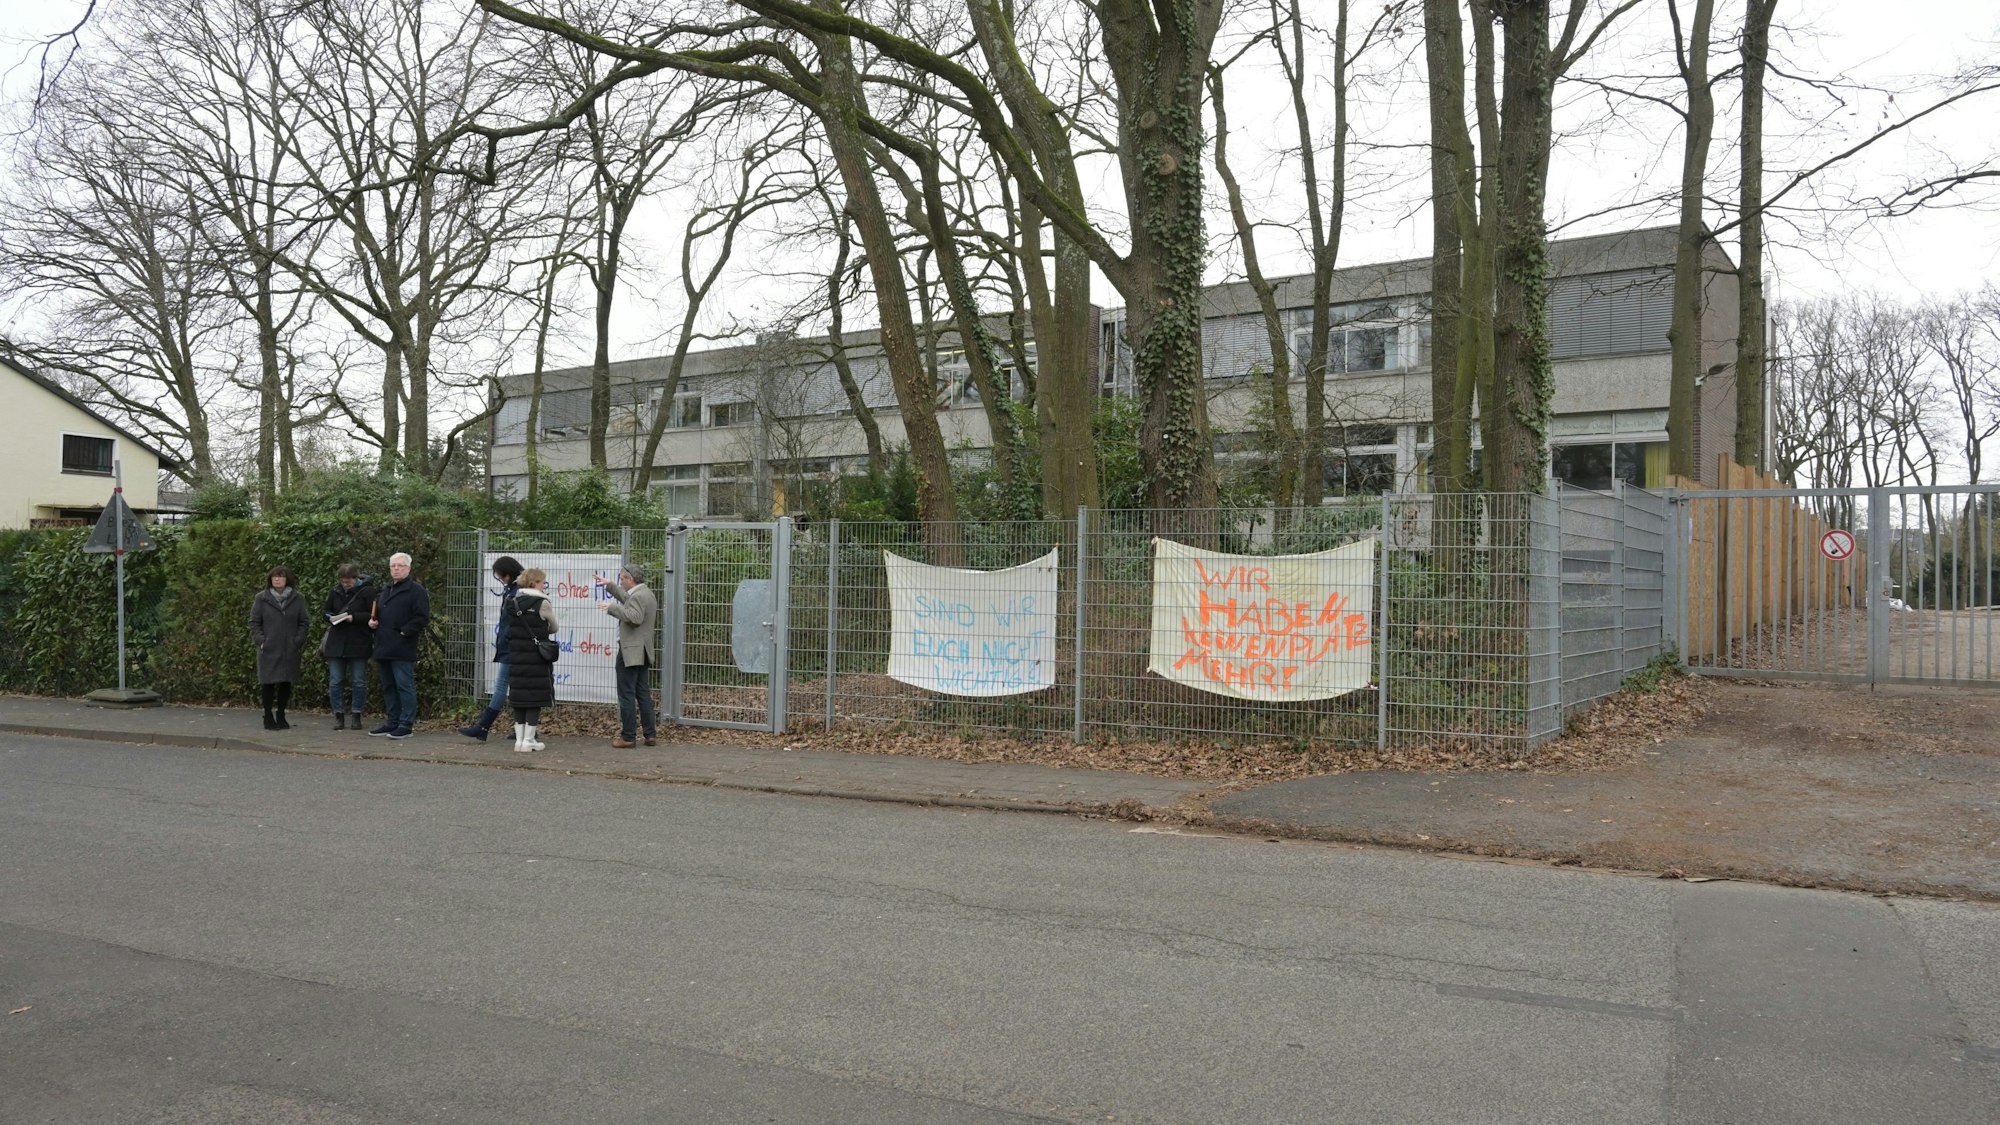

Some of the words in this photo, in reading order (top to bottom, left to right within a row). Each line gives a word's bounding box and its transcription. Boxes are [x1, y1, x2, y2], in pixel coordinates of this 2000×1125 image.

[558, 571, 589, 599] ohne
[1194, 558, 1271, 593] WIR
[914, 595, 976, 628] SIND
[991, 595, 1035, 628] WIR
[1199, 589, 1348, 636] HABEN
[580, 631, 612, 656] ohne
[912, 628, 970, 665] EUCH
[982, 629, 1047, 668] NICHT
[1173, 647, 1299, 693] MEHR!
